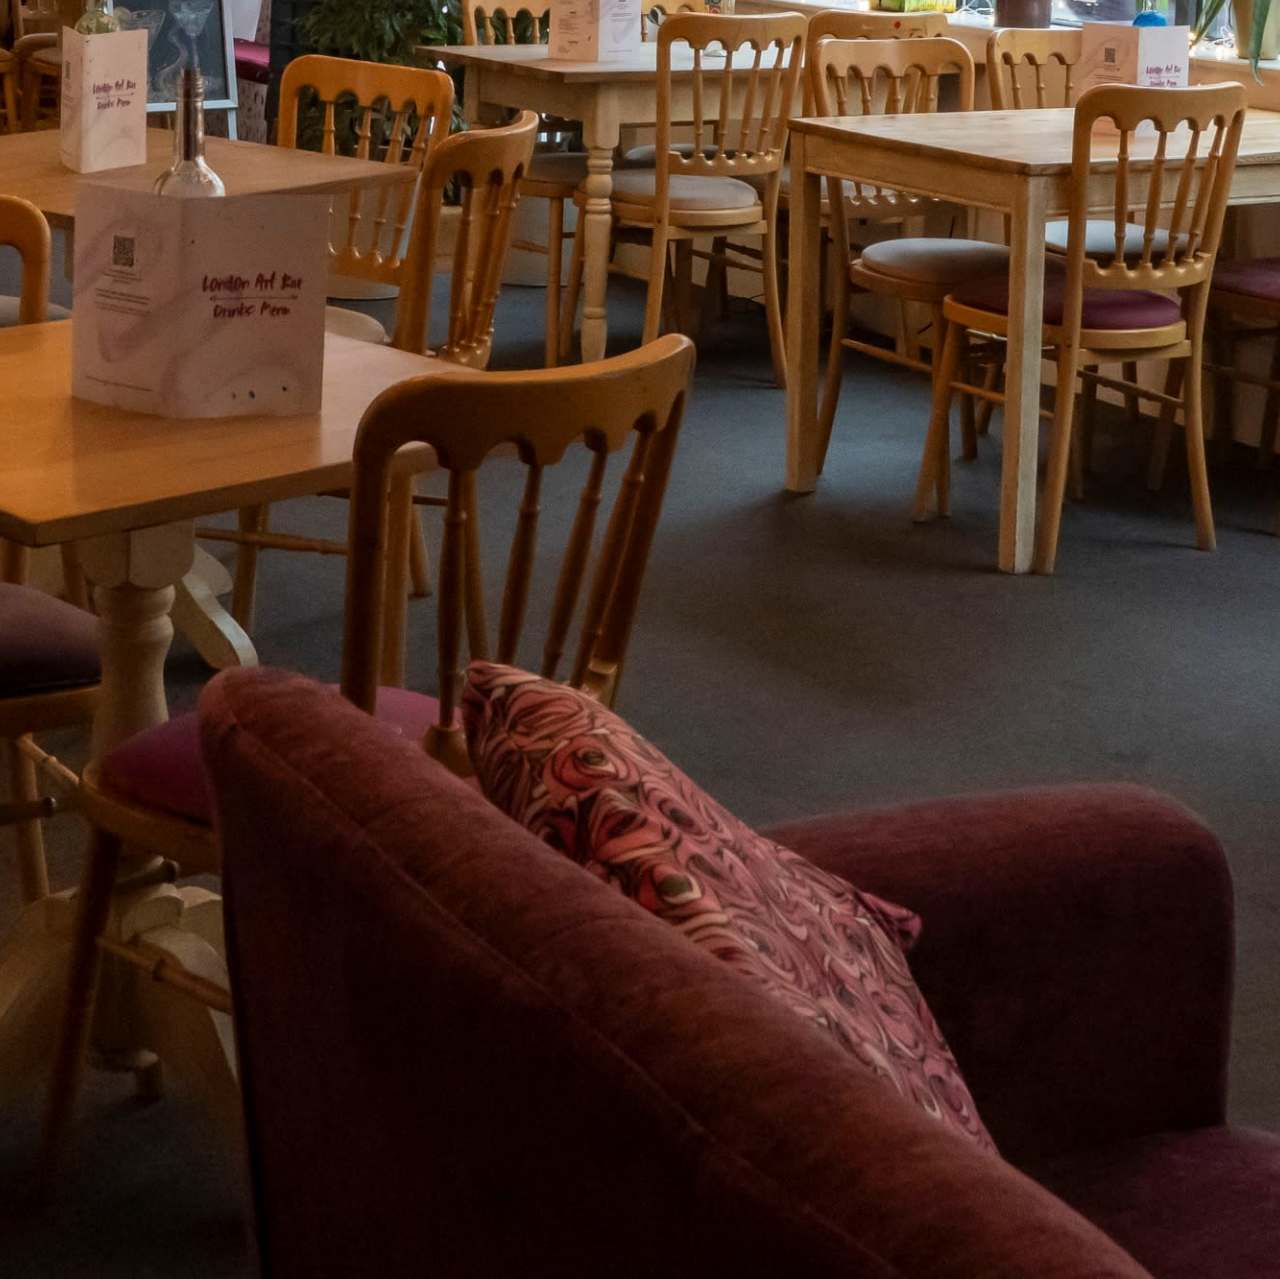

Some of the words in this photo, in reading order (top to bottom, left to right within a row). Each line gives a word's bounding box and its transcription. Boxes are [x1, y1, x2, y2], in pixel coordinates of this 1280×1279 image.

[92, 82, 113, 95] London
[114, 79, 125, 91] Art
[126, 79, 136, 90] Bar
[202, 274, 250, 293] London
[254, 270, 277, 291] Art
[280, 273, 303, 291] Bar
[213, 302, 256, 318] Drinks
[260, 301, 291, 317] Menu
